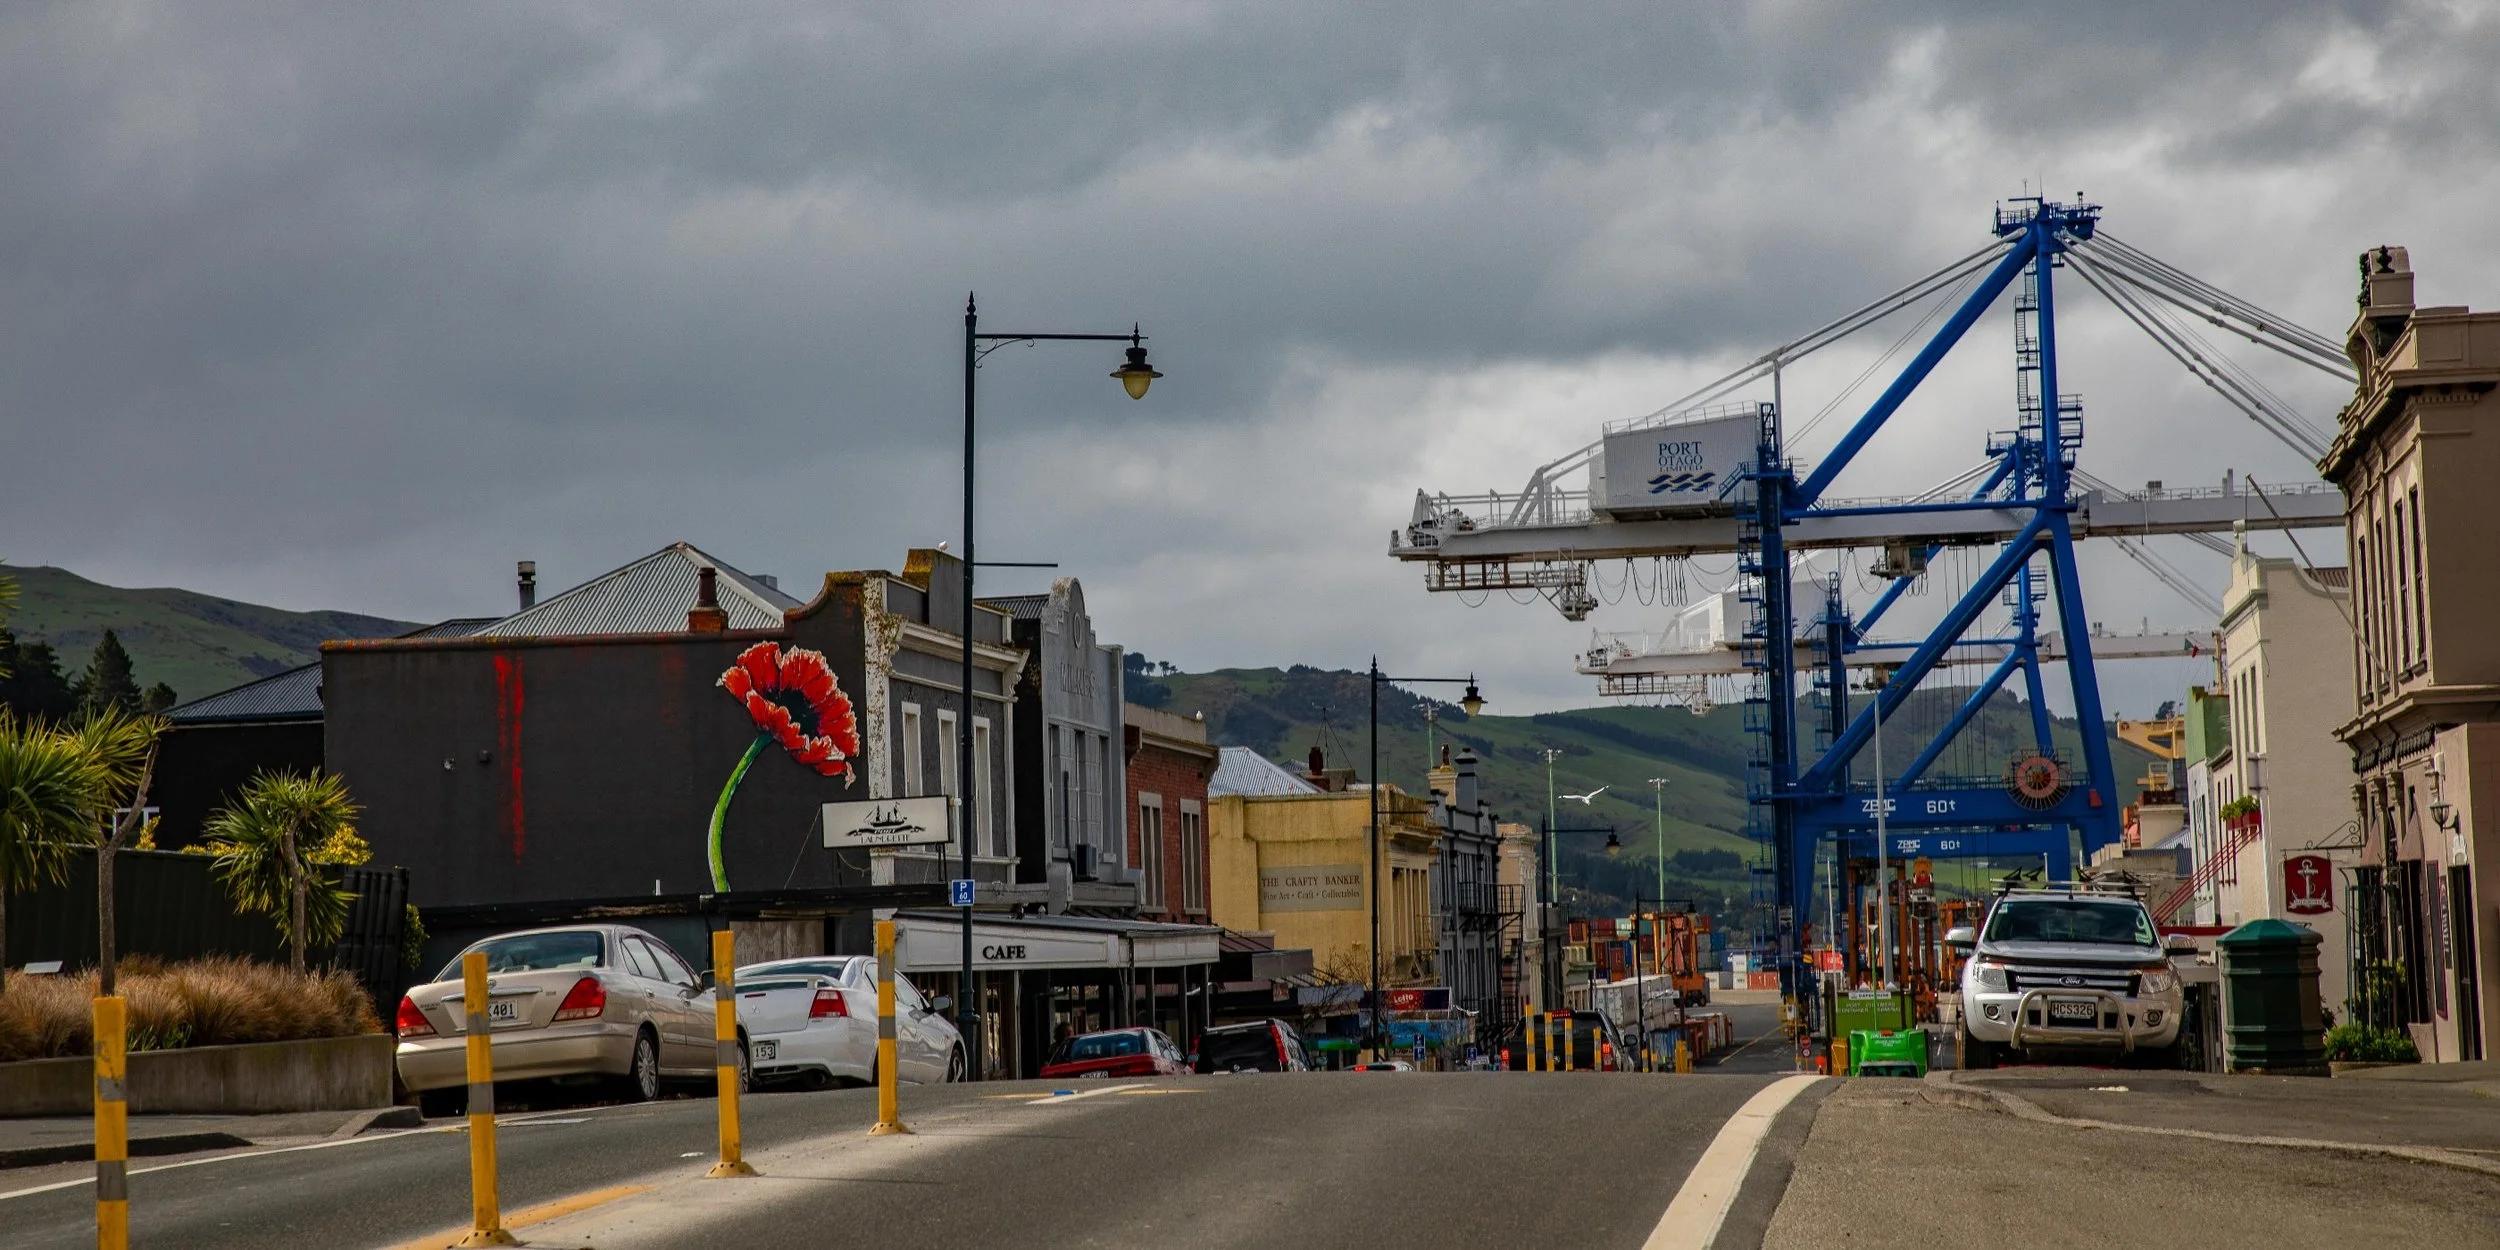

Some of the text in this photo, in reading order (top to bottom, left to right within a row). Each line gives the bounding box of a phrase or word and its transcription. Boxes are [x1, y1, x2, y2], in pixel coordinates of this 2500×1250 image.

[1658, 441, 1702, 456] PORT
[1658, 454, 1703, 467] OTAGO
[960, 882, 967, 891] P
[1262, 874, 1360, 888] THE CRAFTY BANKER
[960, 892, 968, 900] 60
[1263, 891, 1276, 900] Fine
[1279, 891, 1290, 900] Art
[982, 945, 1026, 960] CAFE
[1393, 993, 1414, 1004] Lotto
[2053, 1003, 2093, 1016] HCS326
[756, 1046, 774, 1058] 153
